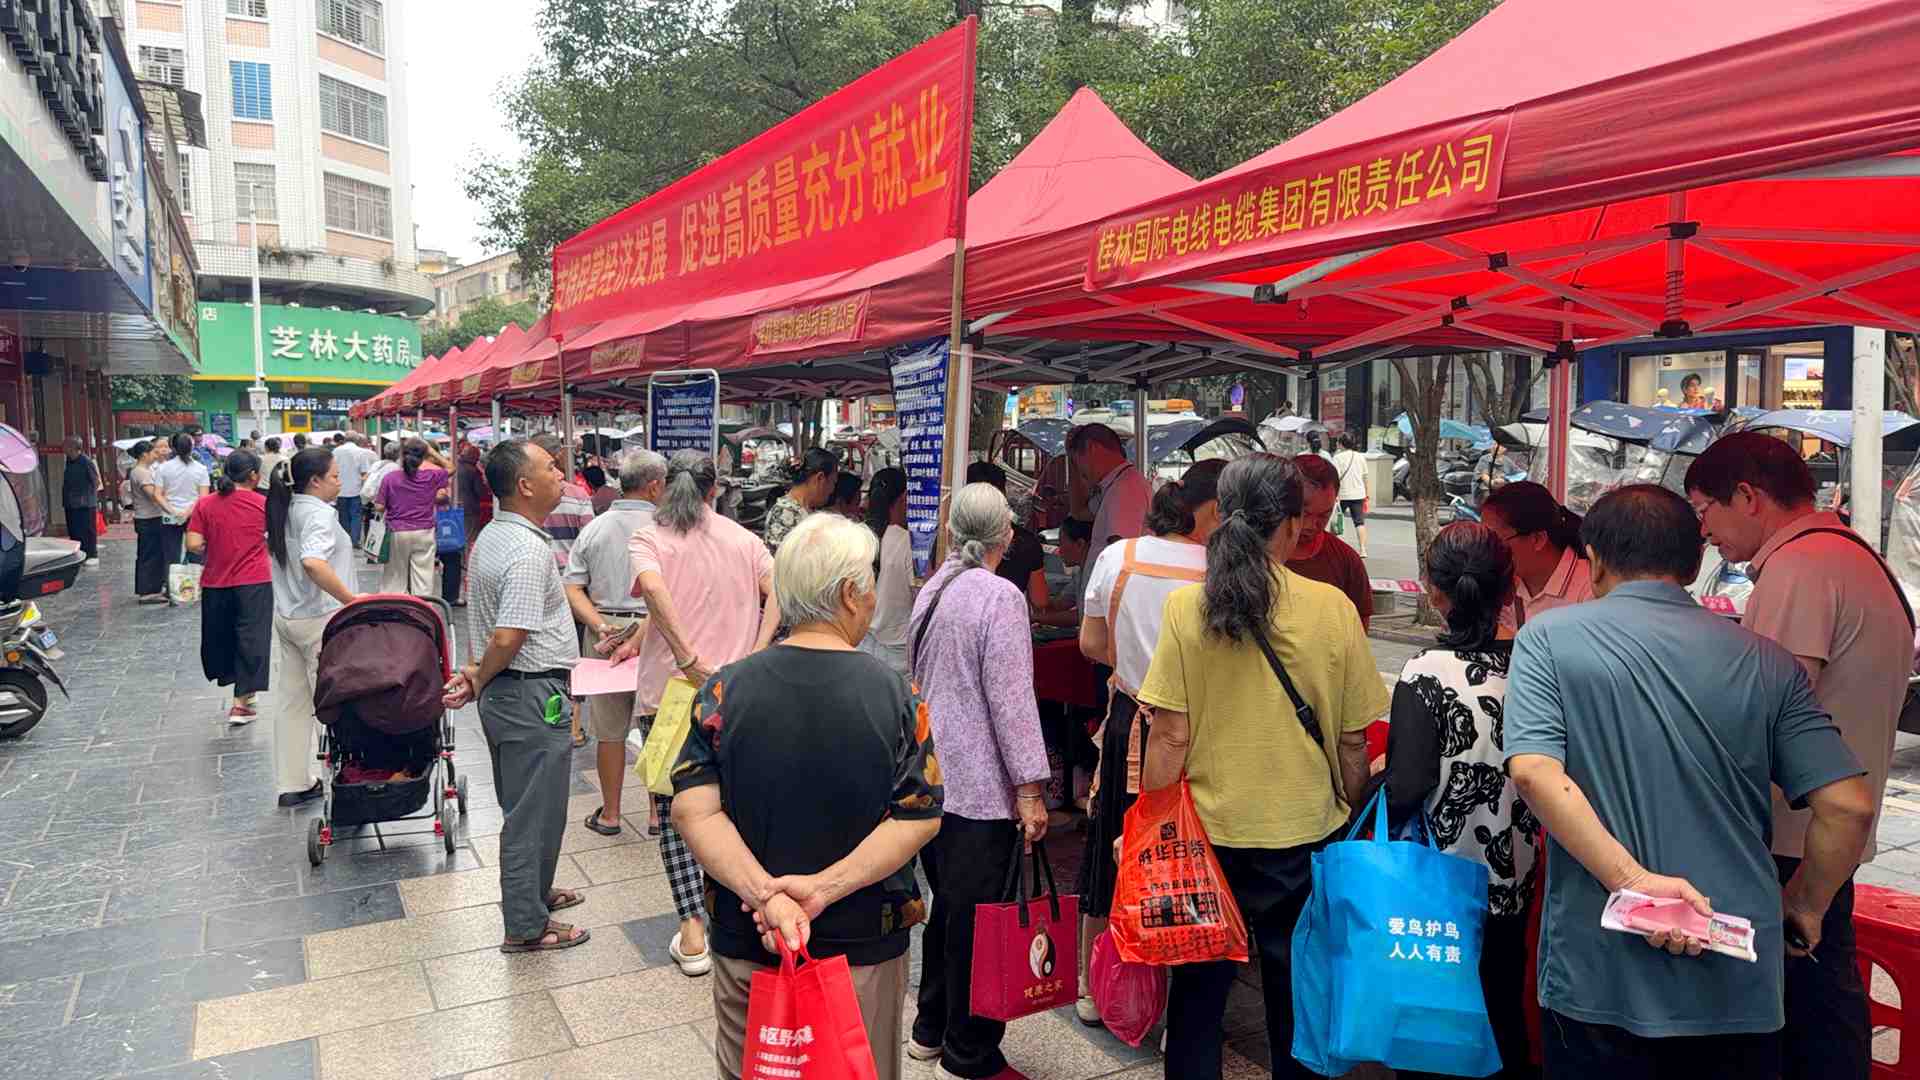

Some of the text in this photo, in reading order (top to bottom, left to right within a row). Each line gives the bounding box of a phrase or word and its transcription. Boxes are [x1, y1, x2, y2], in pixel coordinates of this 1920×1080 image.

[679, 83, 949, 276] 促进高质量充分就业
[1097, 134, 1493, 273] 桂林国际电线电缆集团有限责任公司
[270, 325, 417, 368] 芝林大药房
[1388, 917, 1460, 939] 爱鸟护鸟
[1389, 941, 1461, 964] 人人有责
